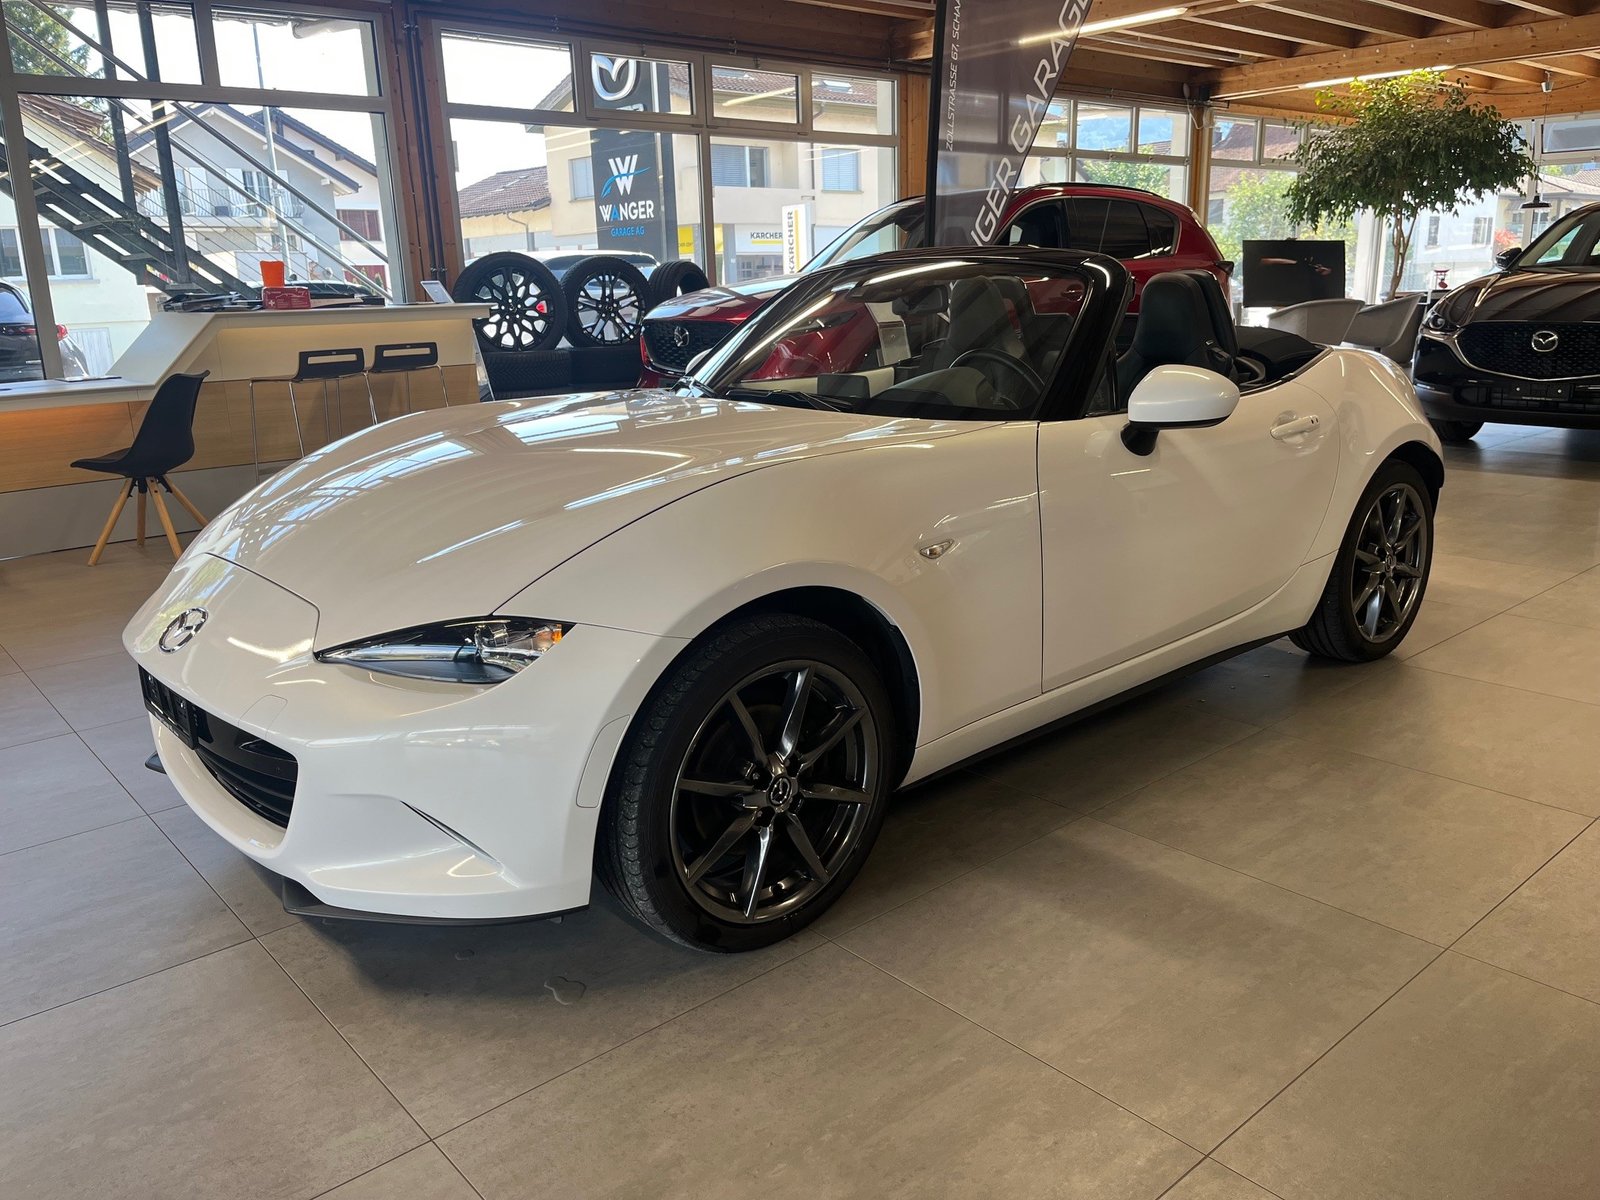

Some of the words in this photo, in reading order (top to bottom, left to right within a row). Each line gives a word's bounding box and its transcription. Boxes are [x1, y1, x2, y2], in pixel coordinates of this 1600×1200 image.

[951, 43, 960, 60] 67,
[946, 62, 958, 151] ZOLLSTRASSE
[599, 200, 655, 222] WANGER
[611, 226, 634, 237] GARAGE
[635, 225, 645, 235] AG
